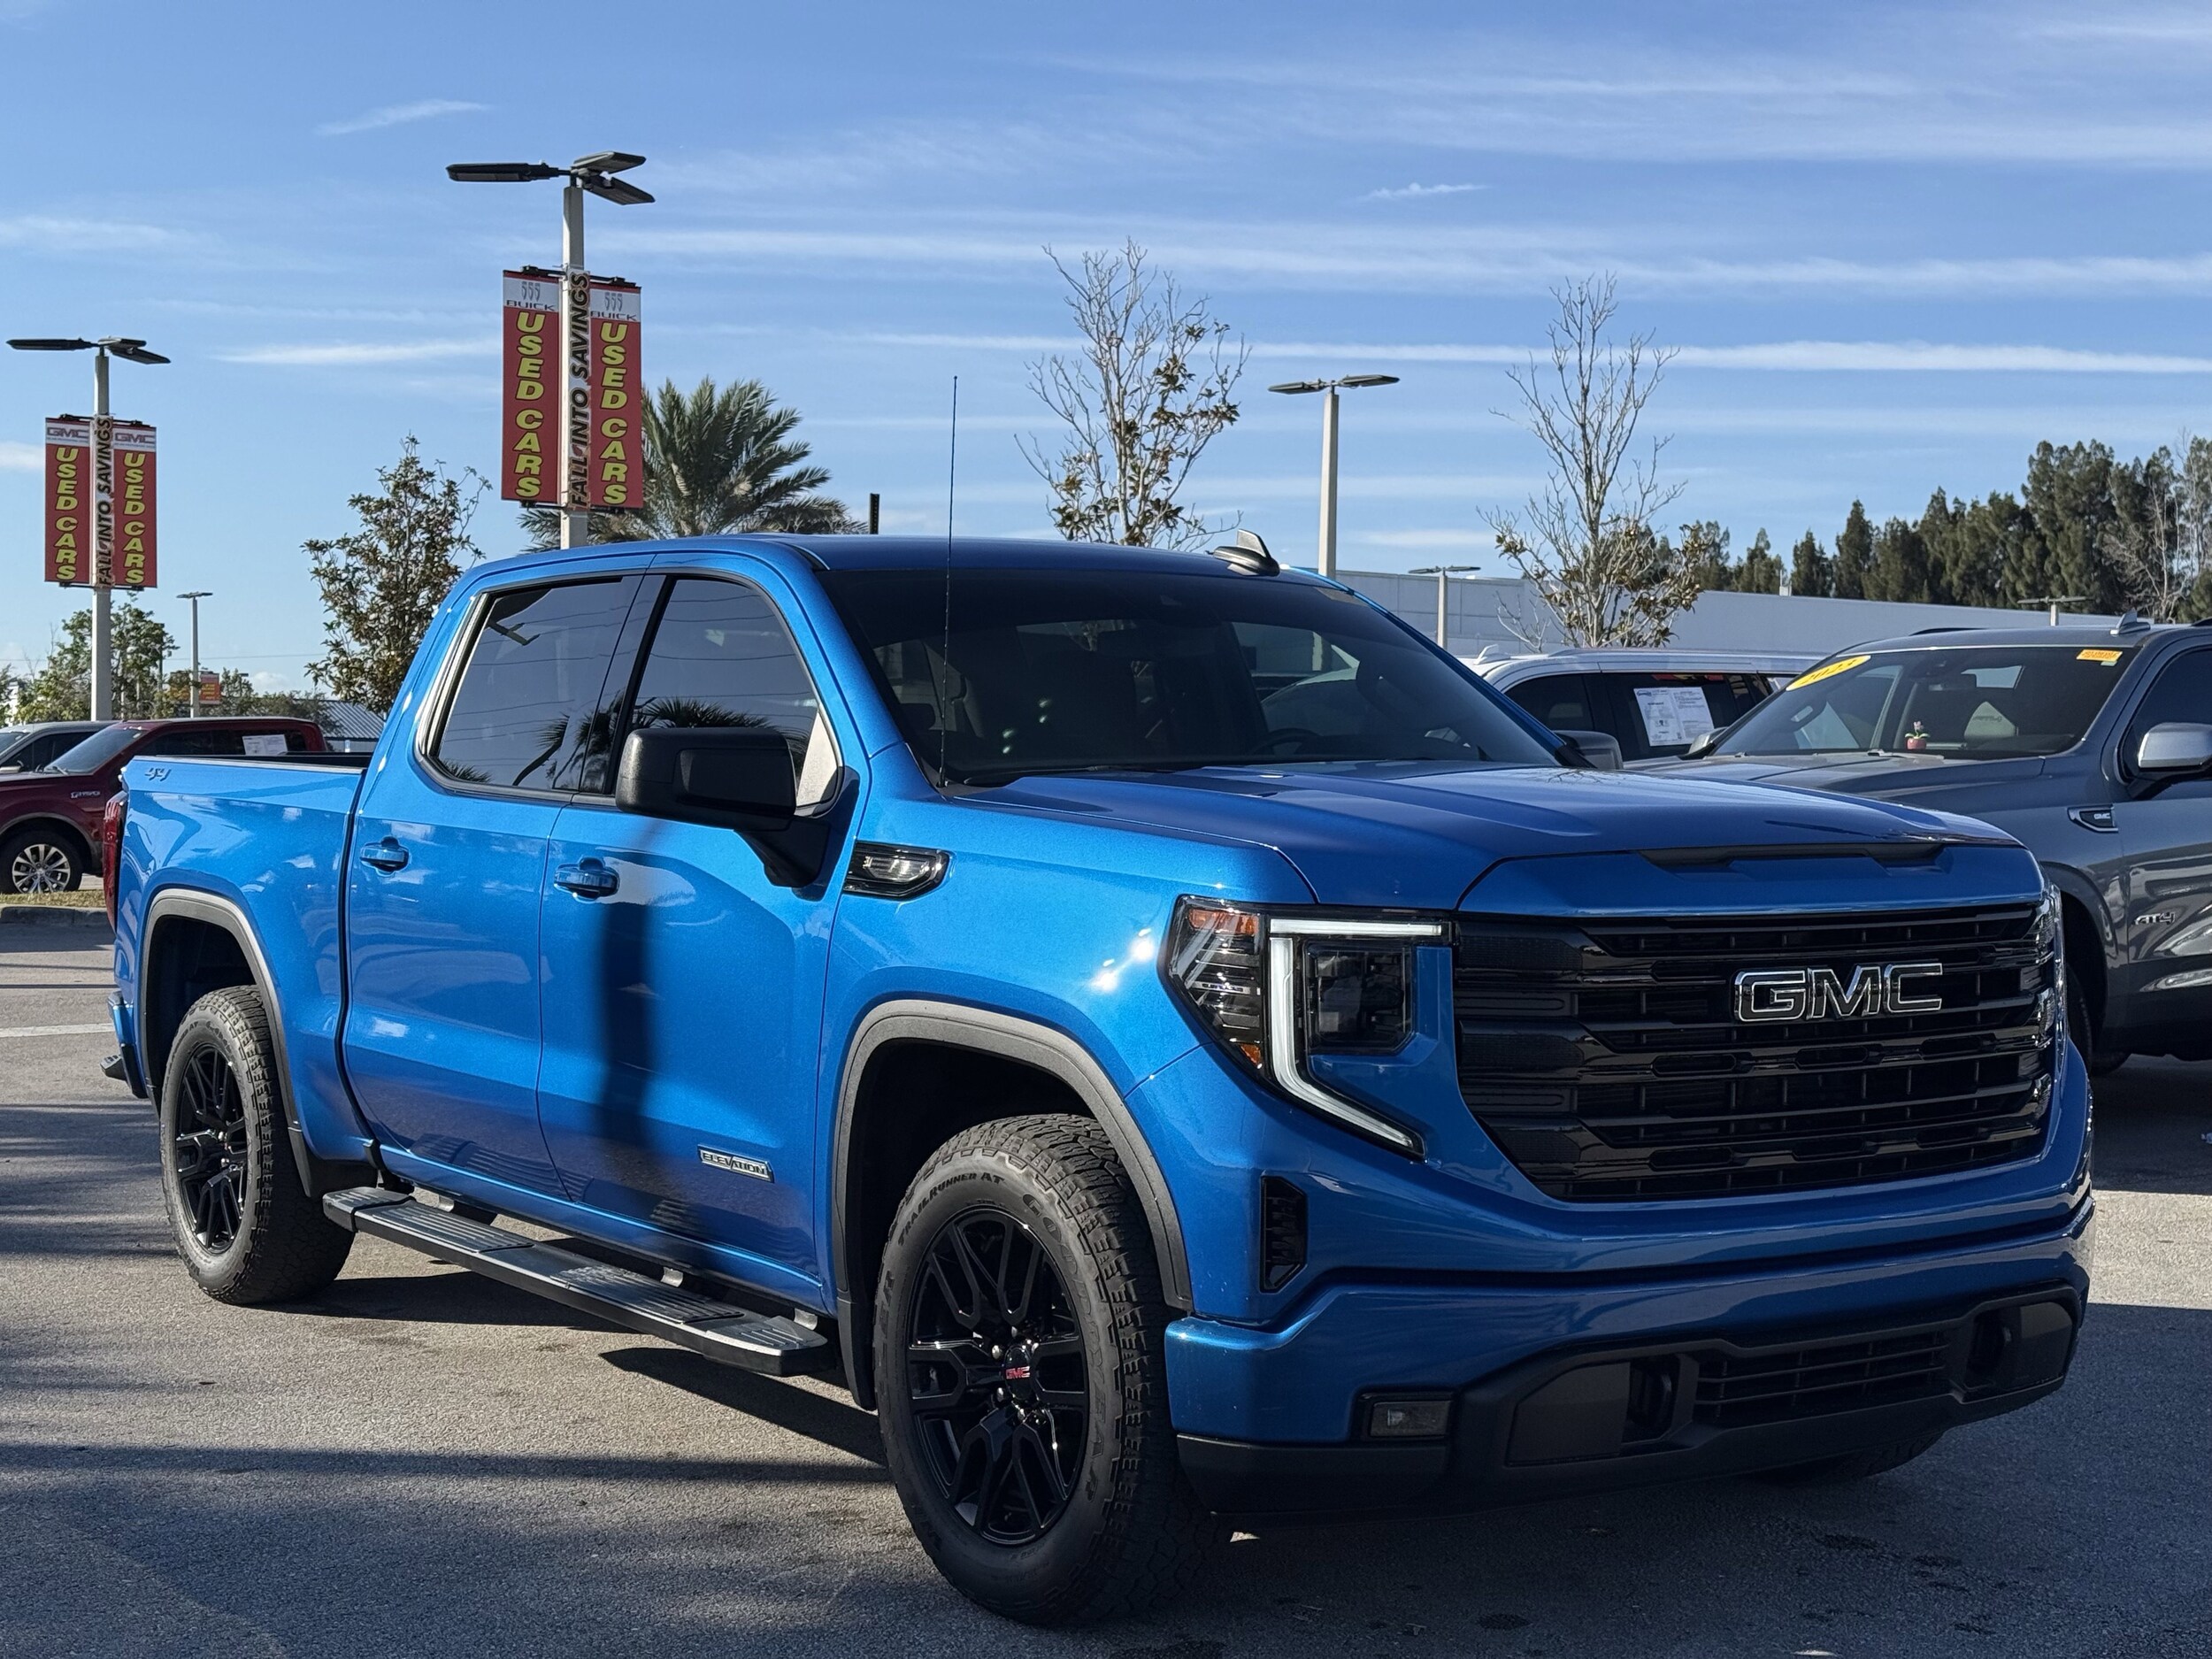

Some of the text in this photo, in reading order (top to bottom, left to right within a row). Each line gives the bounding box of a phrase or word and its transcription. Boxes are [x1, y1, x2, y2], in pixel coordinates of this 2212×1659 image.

[506, 299, 556, 311] BUICK
[590, 311, 637, 321] BUICK
[512, 311, 545, 497] USED CARS
[570, 272, 590, 507] FALL INTO SAVINGS
[599, 322, 629, 504] USED CARS
[47, 426, 89, 439] GMC
[115, 433, 156, 444] GMC
[56, 447, 79, 511] USED
[96, 419, 112, 586] FALL INTO SAVINGS
[124, 453, 146, 515] USED
[54, 517, 78, 580] CARS
[123, 521, 146, 584] CARS
[2135, 910, 2176, 926] AT4
[1733, 963, 1944, 1022] GMC
[702, 1152, 767, 1175] ELEVATION
[979, 1171, 1006, 1187] AT
[1005, 1365, 1031, 1380] GMC
